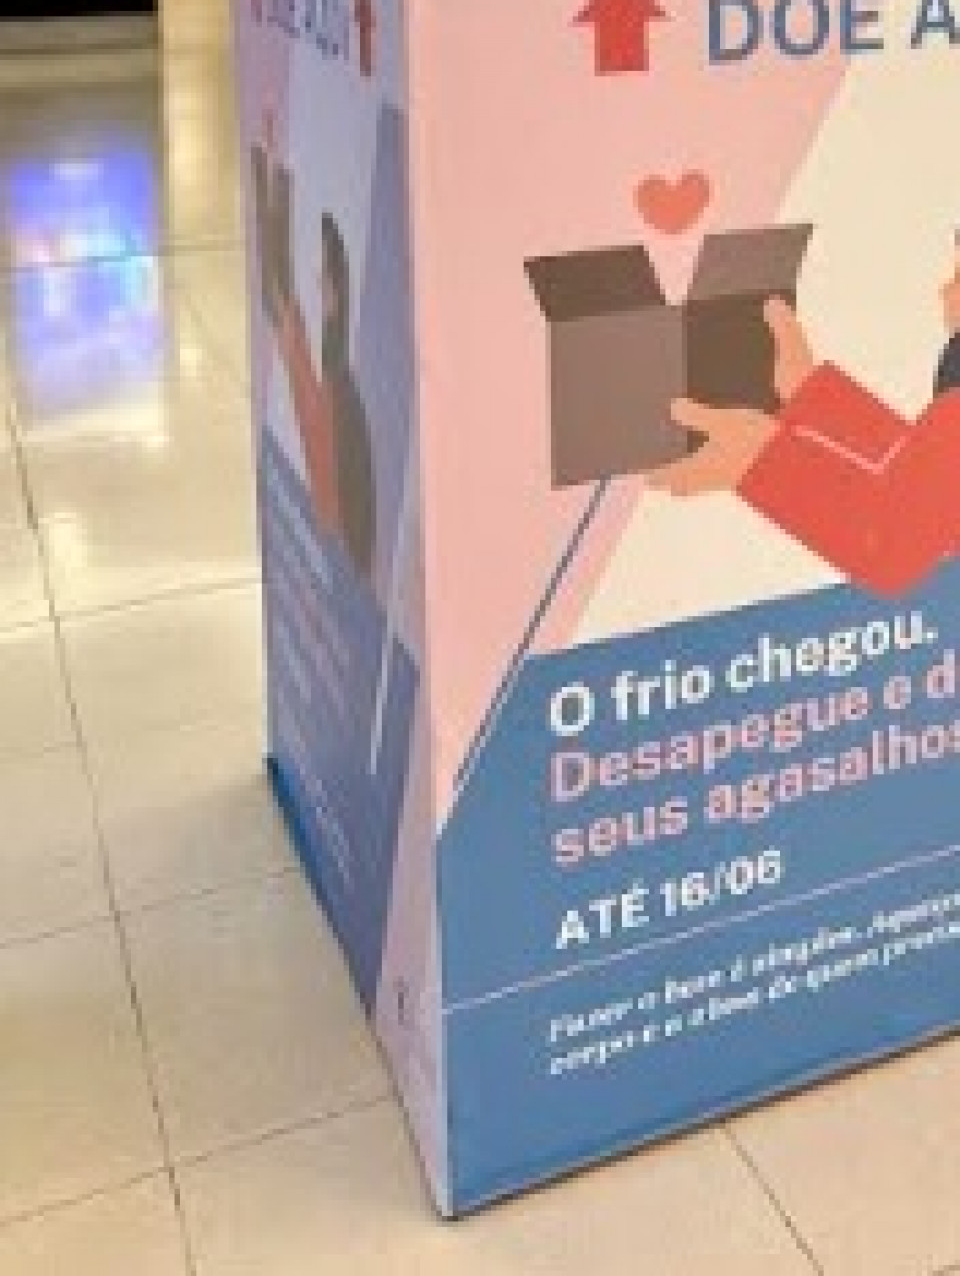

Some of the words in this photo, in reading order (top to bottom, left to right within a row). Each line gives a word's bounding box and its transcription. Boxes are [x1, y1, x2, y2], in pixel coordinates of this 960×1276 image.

[549, 683, 595, 737] O
[611, 659, 714, 721] frio
[725, 610, 938, 694] chegou.
[550, 685, 873, 804] Desapegue
[883, 674, 912, 710] e
[551, 795, 689, 866] seus
[555, 877, 650, 950] ATÉ
[659, 846, 786, 917] 16/06
